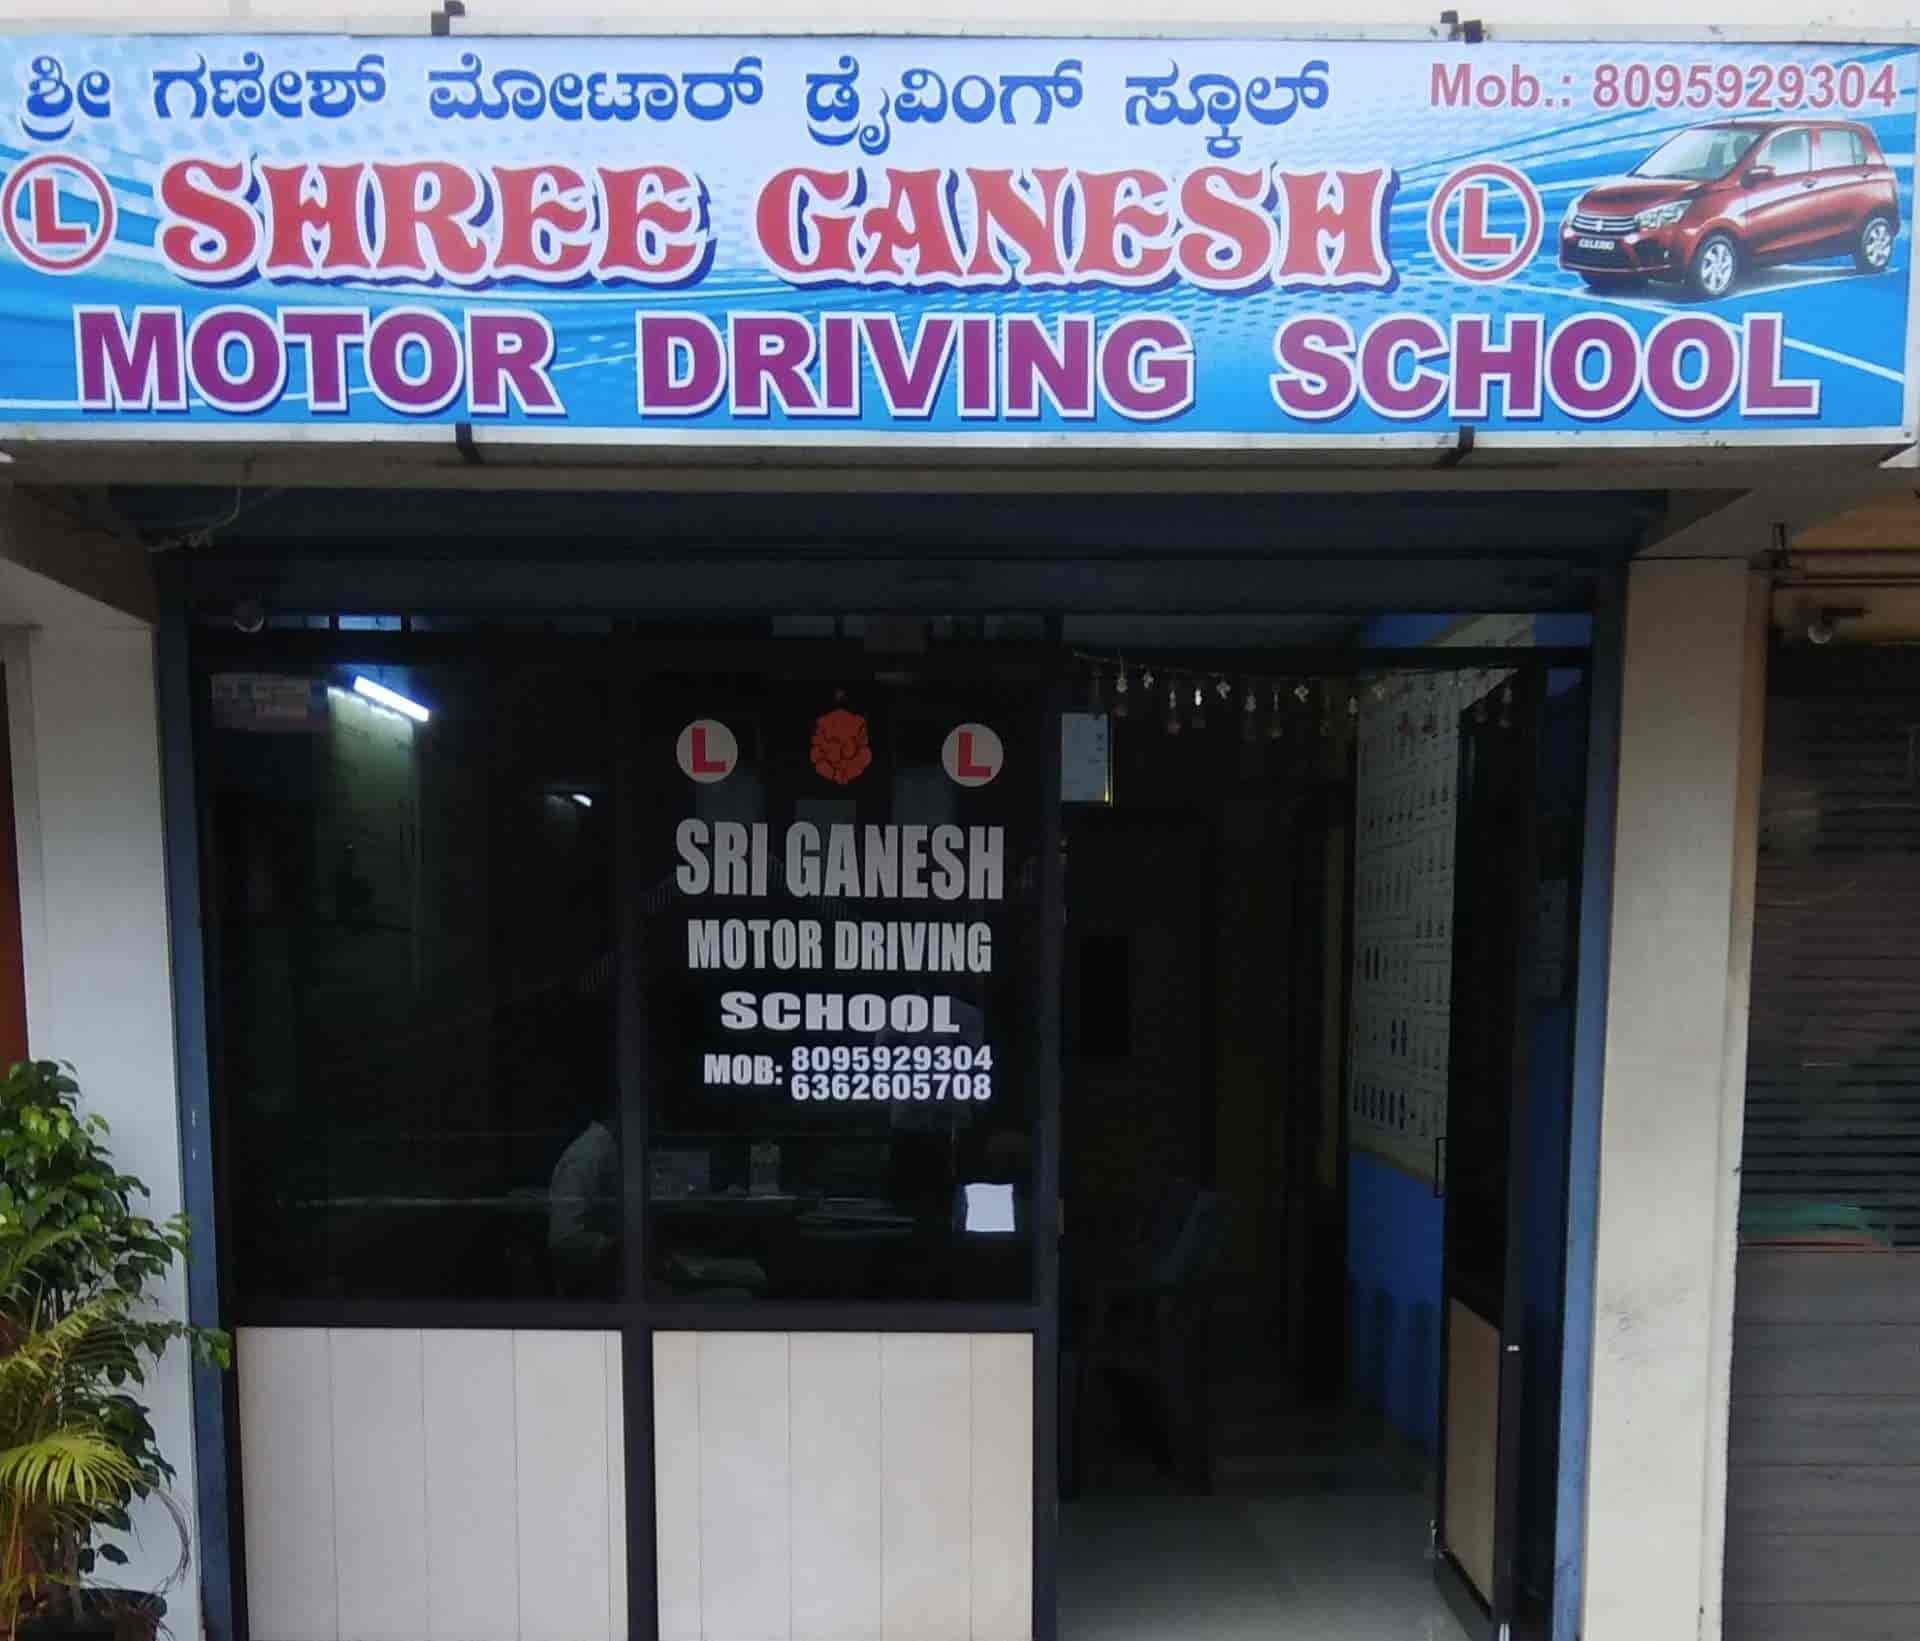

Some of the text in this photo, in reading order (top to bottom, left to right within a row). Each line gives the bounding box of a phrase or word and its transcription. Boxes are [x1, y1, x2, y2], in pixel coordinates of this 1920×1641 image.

[21, 53, 1330, 159] ಶ್ರೀ ಗಣೇಶ್ ಮೋಟಾರ್ ಡ್ರೈವಿಂಗ್ ಸ್ಕೂಲ್
[1430, 62, 1896, 109] Mob.: 8095929304
[29, 177, 88, 246] L
[157, 157, 1396, 289] SHREE GANESH
[1460, 186, 1515, 258] L
[76, 308, 1822, 420] MOTOR DRIVING SCHOOL
[691, 726, 727, 774] L
[957, 731, 992, 778] L
[675, 818, 1005, 900] SRI GANESH
[687, 918, 993, 972] MOTOR DRIVING
[719, 991, 961, 1033] SCHOOL
[703, 1053, 784, 1085] MOB:
[791, 1044, 994, 1073] 8095929304
[791, 1073, 993, 1101] 6362605708
